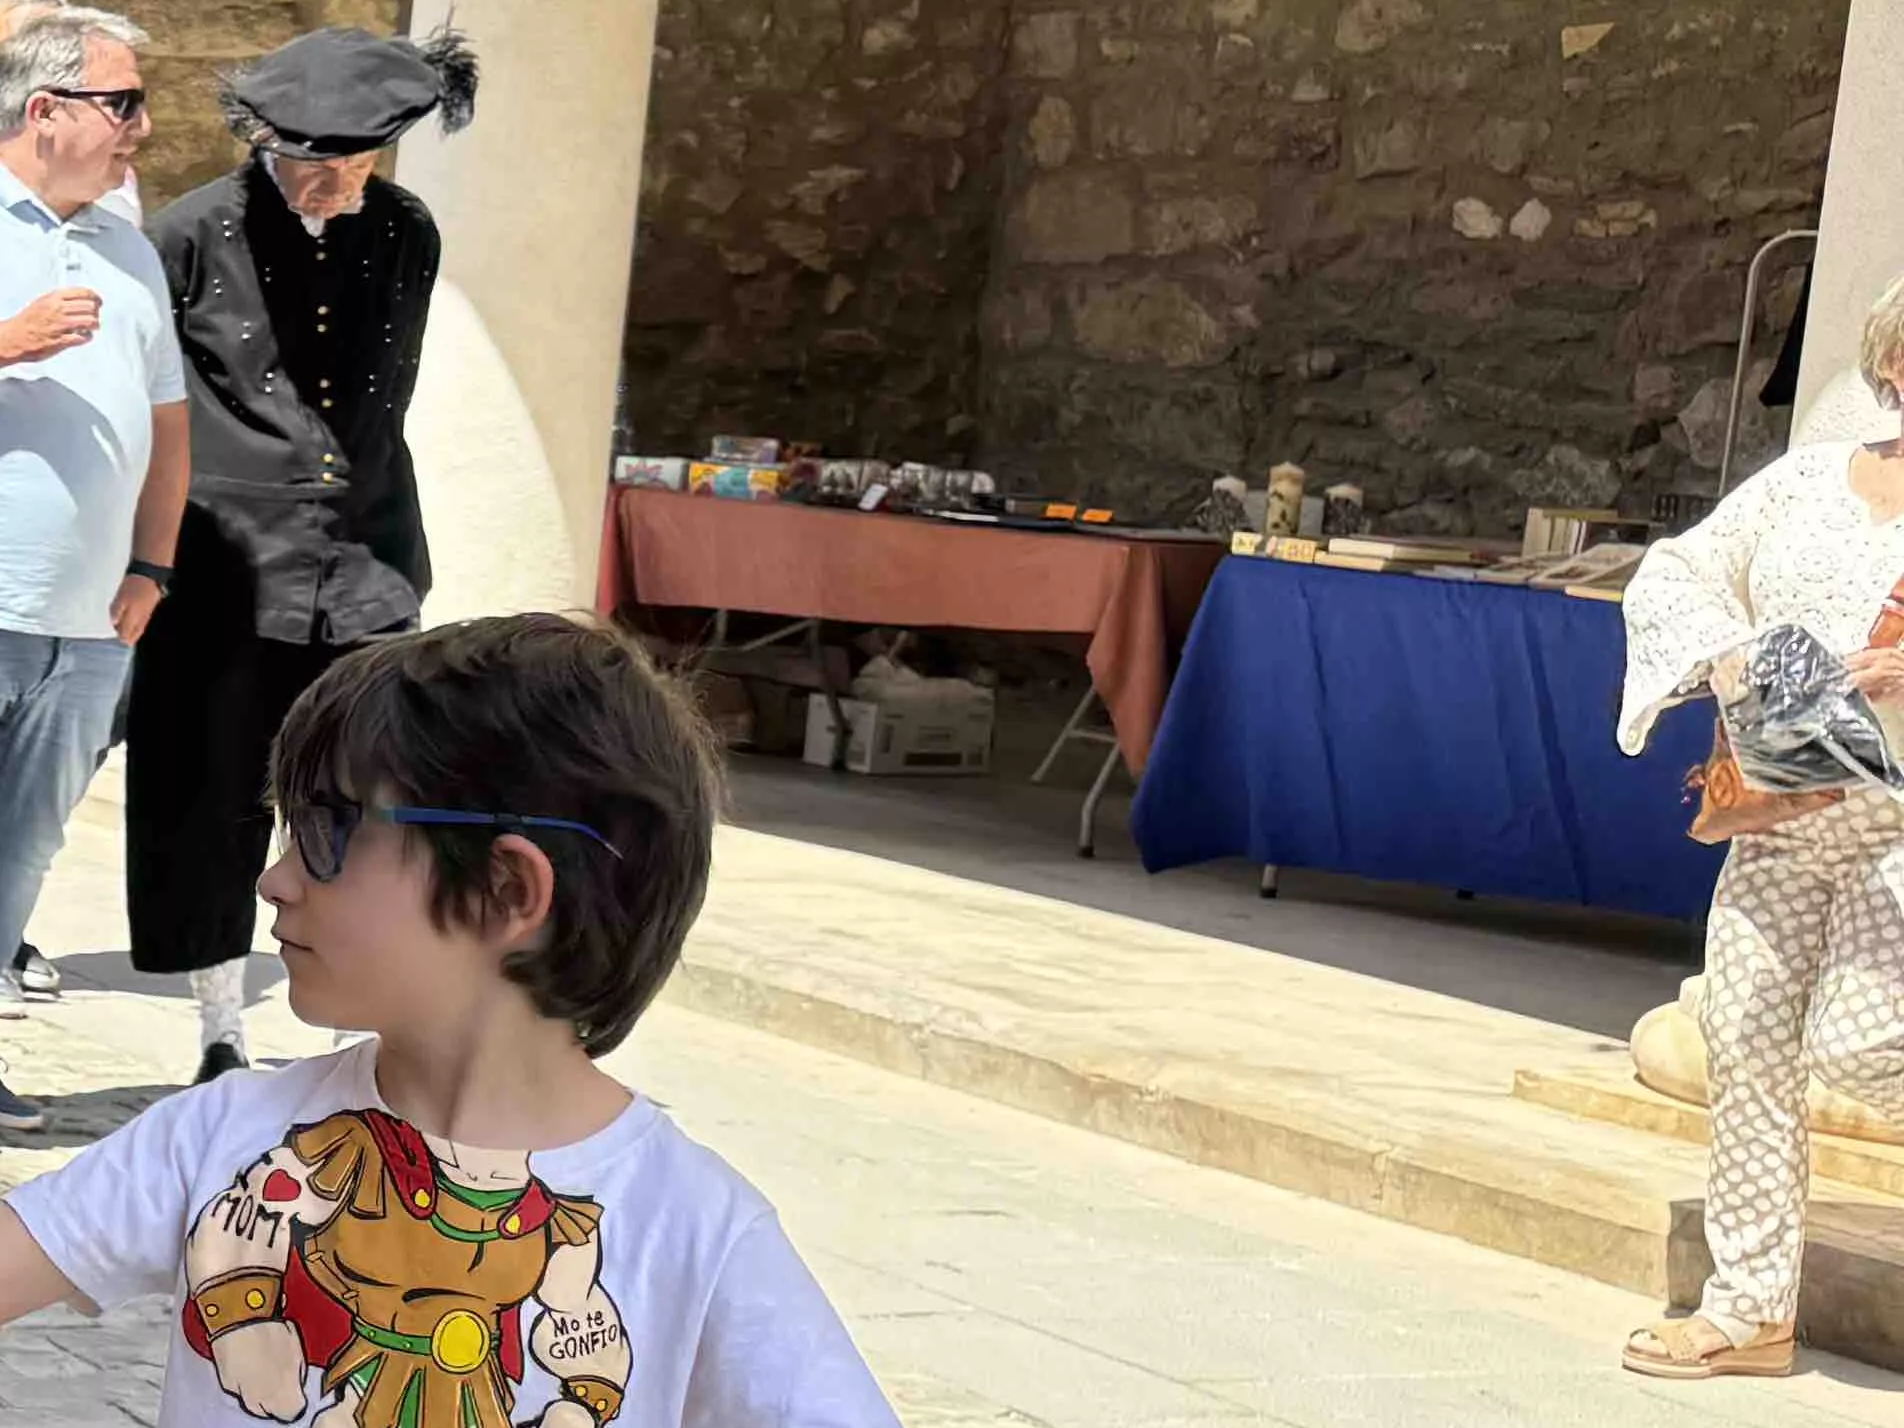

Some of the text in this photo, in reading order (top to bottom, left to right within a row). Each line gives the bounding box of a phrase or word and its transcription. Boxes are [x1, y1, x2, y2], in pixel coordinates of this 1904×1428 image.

[210, 1192, 284, 1248] MOM
[548, 1323, 618, 1360] GONFIO
[553, 1310, 605, 1338] Mo te
